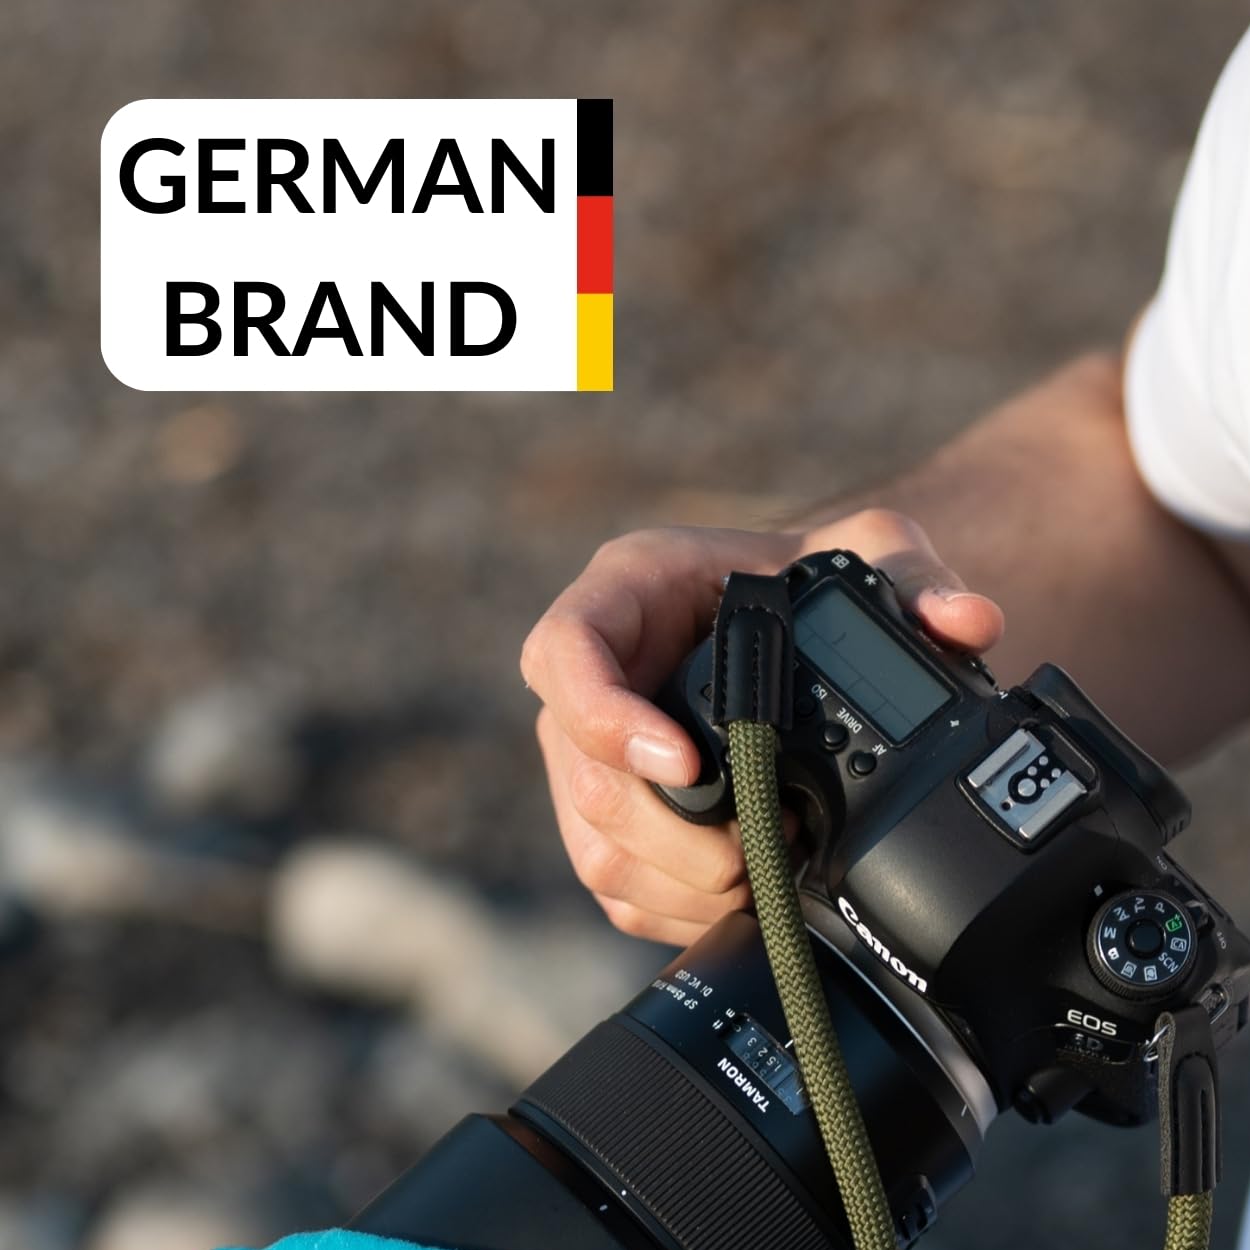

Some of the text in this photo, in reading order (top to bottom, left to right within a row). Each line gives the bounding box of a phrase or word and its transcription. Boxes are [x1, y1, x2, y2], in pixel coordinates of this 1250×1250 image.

[811, 684, 888, 756] AF DRIVE ISO
[1134, 896, 1146, 914] Tv
[1113, 906, 1131, 922] Av
[1103, 926, 1117, 939] M
[835, 895, 928, 994] Canon
[1107, 947, 1119, 960] B
[1158, 951, 1179, 973] SCN
[688, 977, 701, 989] VC
[700, 985, 713, 998] Di
[683, 998, 698, 1010] SP
[1067, 1008, 1117, 1036] EOS
[717, 1057, 771, 1113] TAMRON
